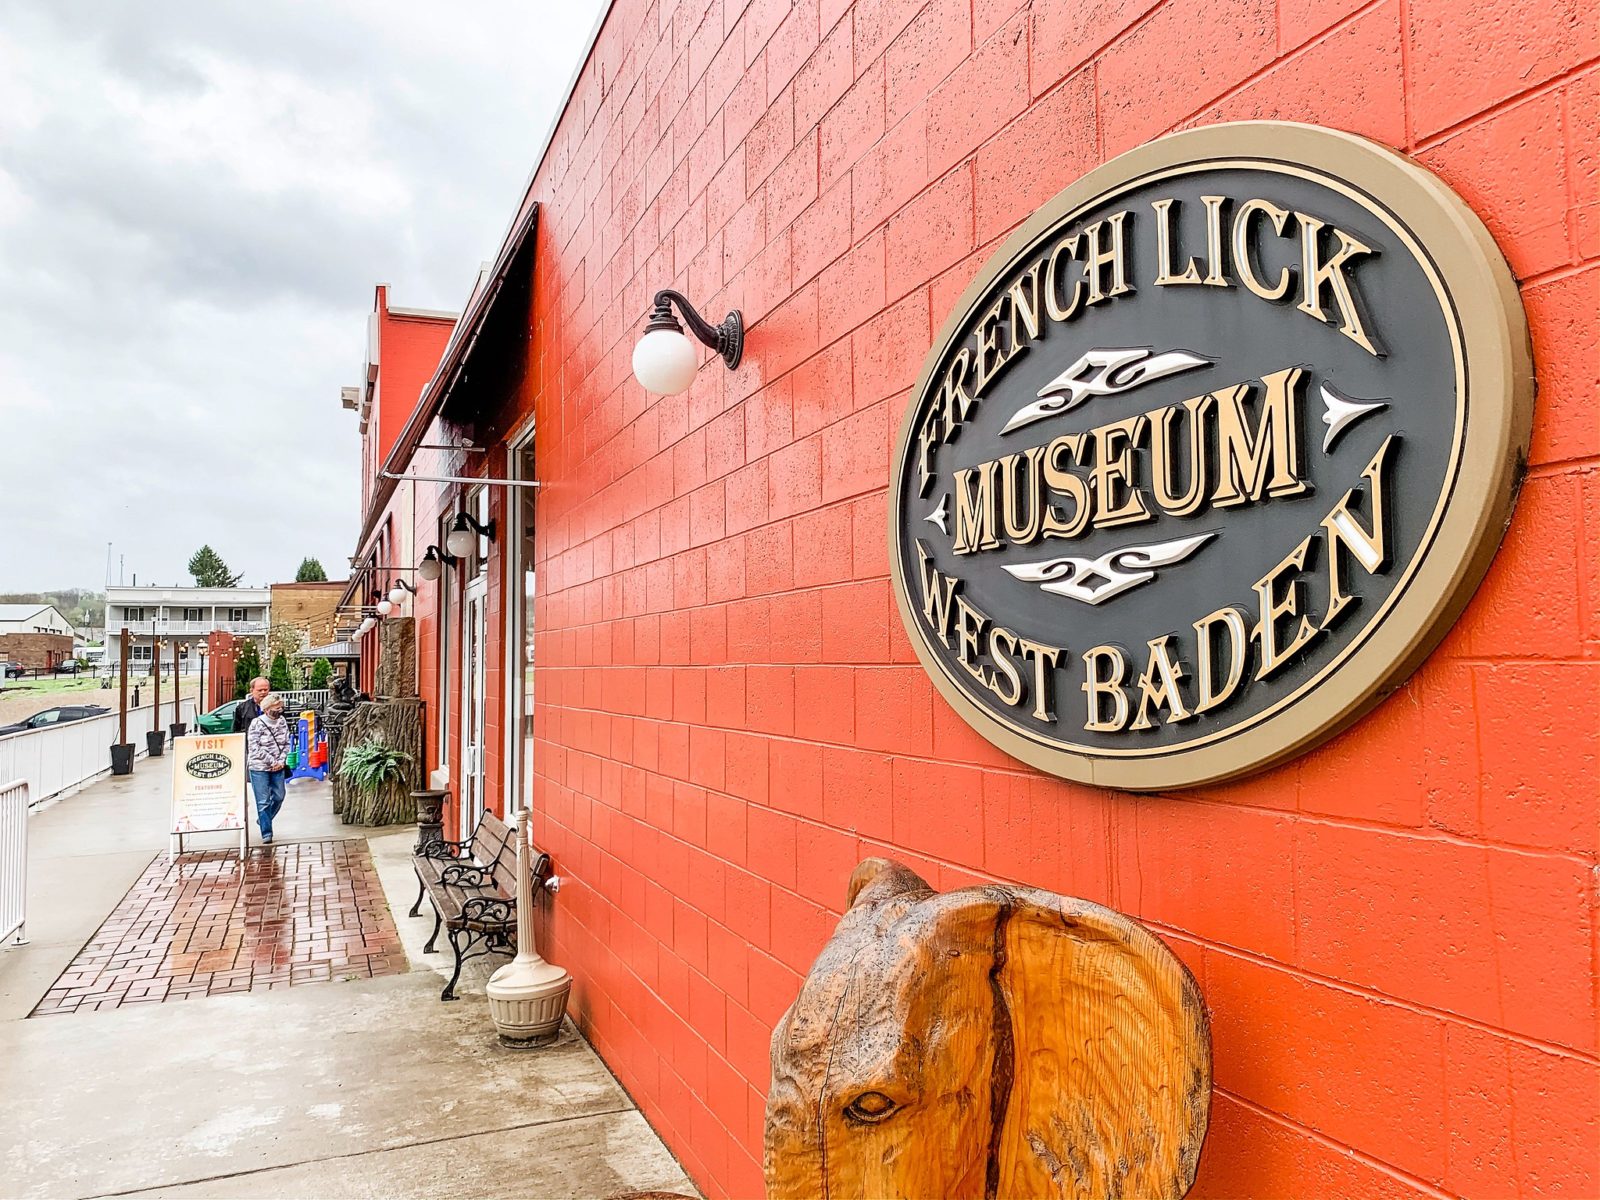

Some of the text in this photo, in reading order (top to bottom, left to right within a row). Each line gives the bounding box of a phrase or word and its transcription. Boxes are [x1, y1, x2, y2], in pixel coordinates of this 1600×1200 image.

[917, 195, 1380, 494] FRENCH LICK
[952, 366, 1307, 556] MUSEUM
[915, 434, 1395, 732] WEST BADEN
[195, 739, 225, 750] VISIT
[189, 754, 230, 766] FRENCH LICK
[194, 761, 224, 770] MUSEUM
[188, 767, 207, 778] WEST
